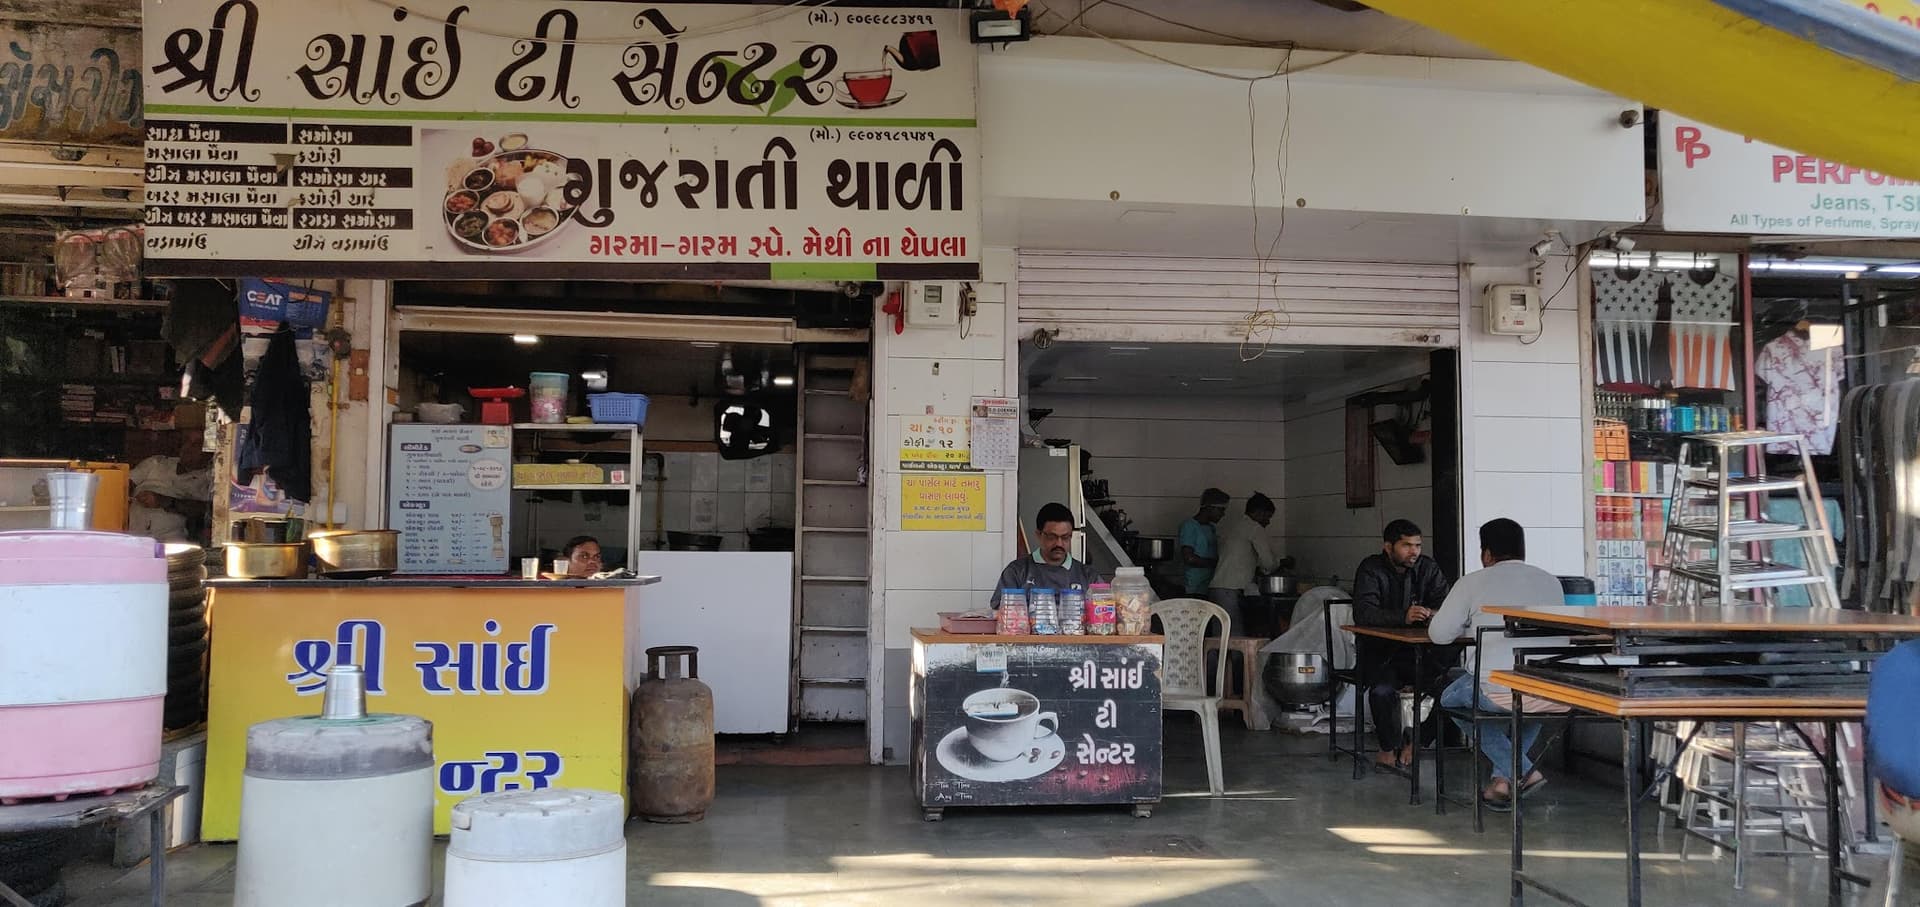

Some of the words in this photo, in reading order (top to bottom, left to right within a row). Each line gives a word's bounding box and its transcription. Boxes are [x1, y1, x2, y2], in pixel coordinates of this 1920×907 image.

[847, 14, 933, 25] ૯૦૯૯૮૮૩૪૧૧
[152, 0, 260, 102] શ્રી
[295, 6, 469, 105] સાંઈ
[495, 8, 580, 108] ટી
[612, 9, 838, 110] સેન્ટર
[299, 125, 353, 144] સમોસા
[848, 130, 935, 142] ૯૯૦૪૧૮૧૫૪૧
[146, 147, 200, 162] મસાલા
[299, 147, 341, 164] કચોરી
[186, 170, 241, 185] મસાલા
[299, 168, 353, 186] સમોસા
[359, 170, 387, 186] ચાટ
[563, 137, 798, 228] ગુજરાતી
[826, 138, 963, 211] થાળી
[146, 190, 180, 205] બટર
[186, 190, 240, 205] મસાલા
[299, 189, 341, 207] કચોરી
[347, 191, 376, 207] ચાટ
[1810, 192, 1876, 214] Jeans,
[177, 212, 206, 227] બટર
[211, 212, 257, 227] મસાલા
[298, 213, 336, 228] રગડા
[342, 210, 396, 229] સમોસા
[1730, 213, 1748, 226] All
[1753, 214, 1793, 229] Types
[1797, 215, 1811, 228] of
[1815, 216, 1876, 230] Perfume,
[803, 227, 851, 257] મેથી
[863, 235, 889, 257] ના
[901, 227, 967, 257] થેપલા
[247, 290, 284, 306] CEAT
[938, 425, 953, 434] ૧૦
[938, 439, 954, 449] ૧૨
[286, 618, 386, 696] શ્રી
[414, 618, 558, 696] સાંઈ
[1068, 660, 1096, 691] શ્રી
[1100, 659, 1145, 690] સાંઈ
[1095, 698, 1117, 729] ટી
[1076, 733, 1137, 766] સેન્ટર
